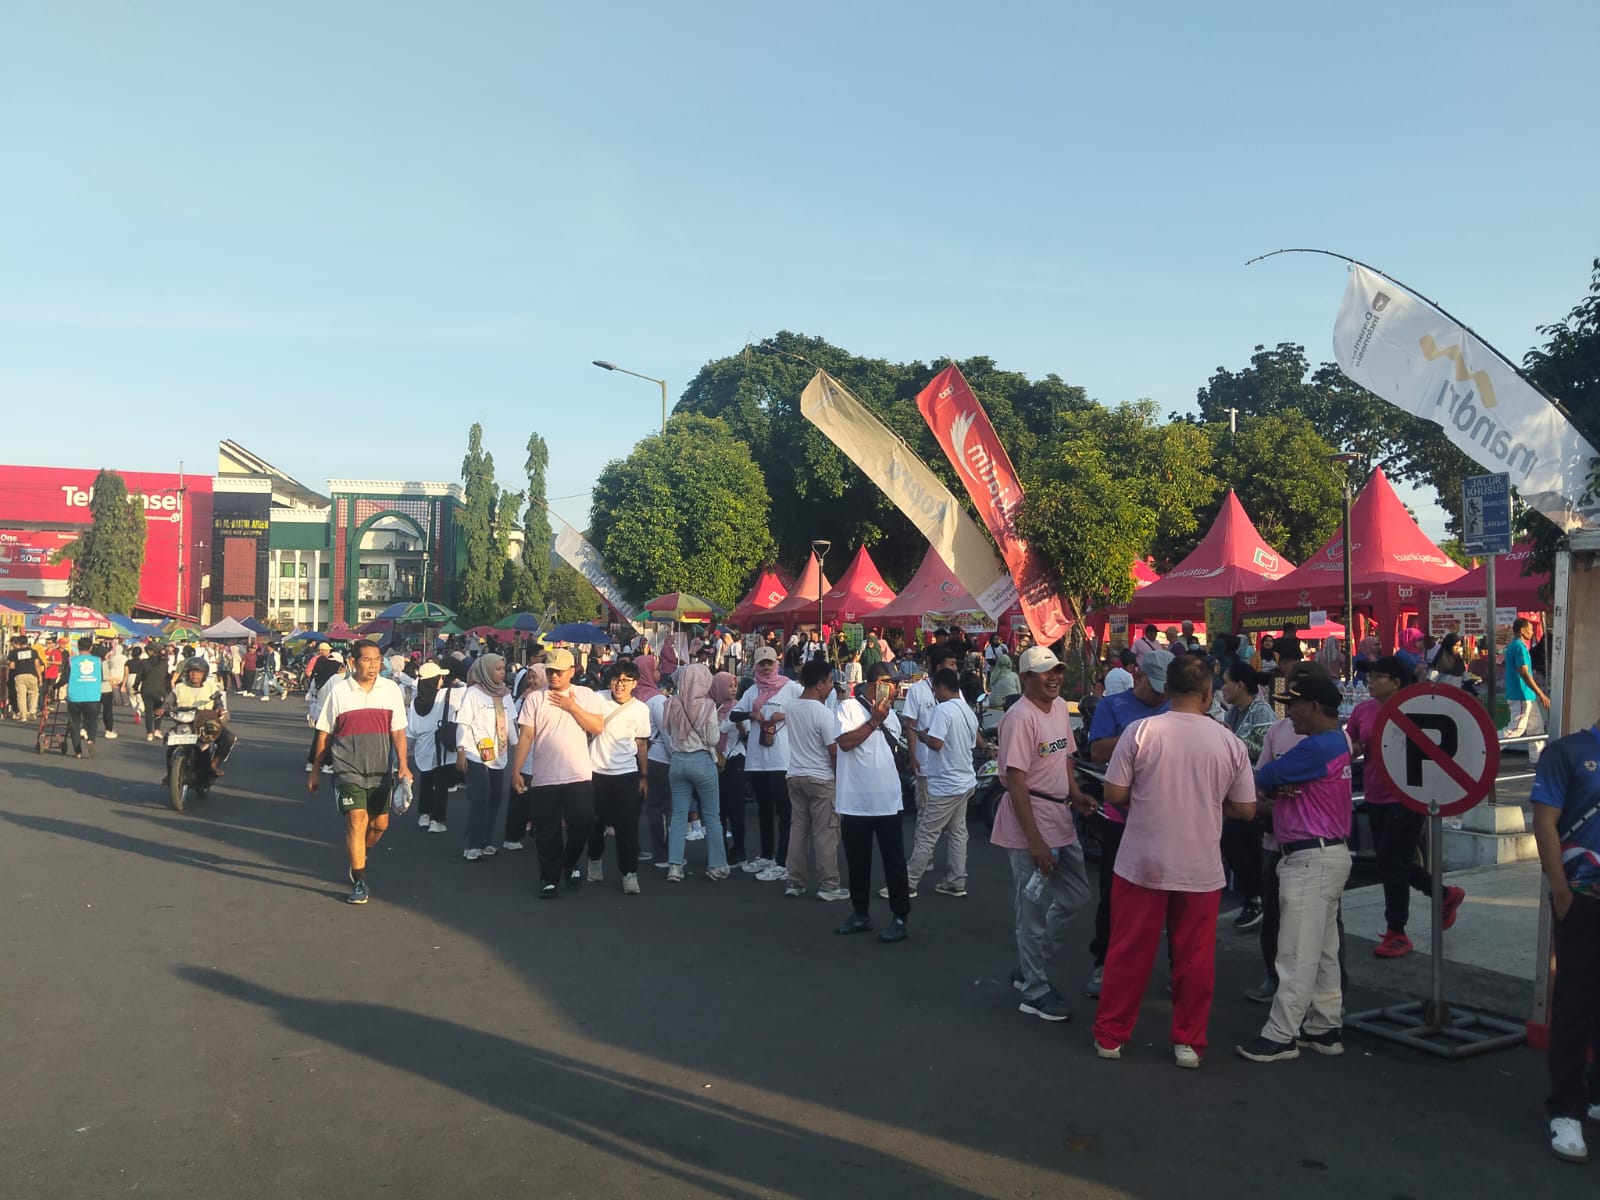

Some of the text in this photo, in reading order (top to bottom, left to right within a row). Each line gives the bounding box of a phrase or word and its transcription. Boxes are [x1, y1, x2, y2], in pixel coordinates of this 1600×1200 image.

[1467, 485, 1505, 496] KHUSUS
[1471, 477, 1501, 488] JALUR
[61, 486, 181, 510] Telmsel
[1406, 713, 1458, 787] P
